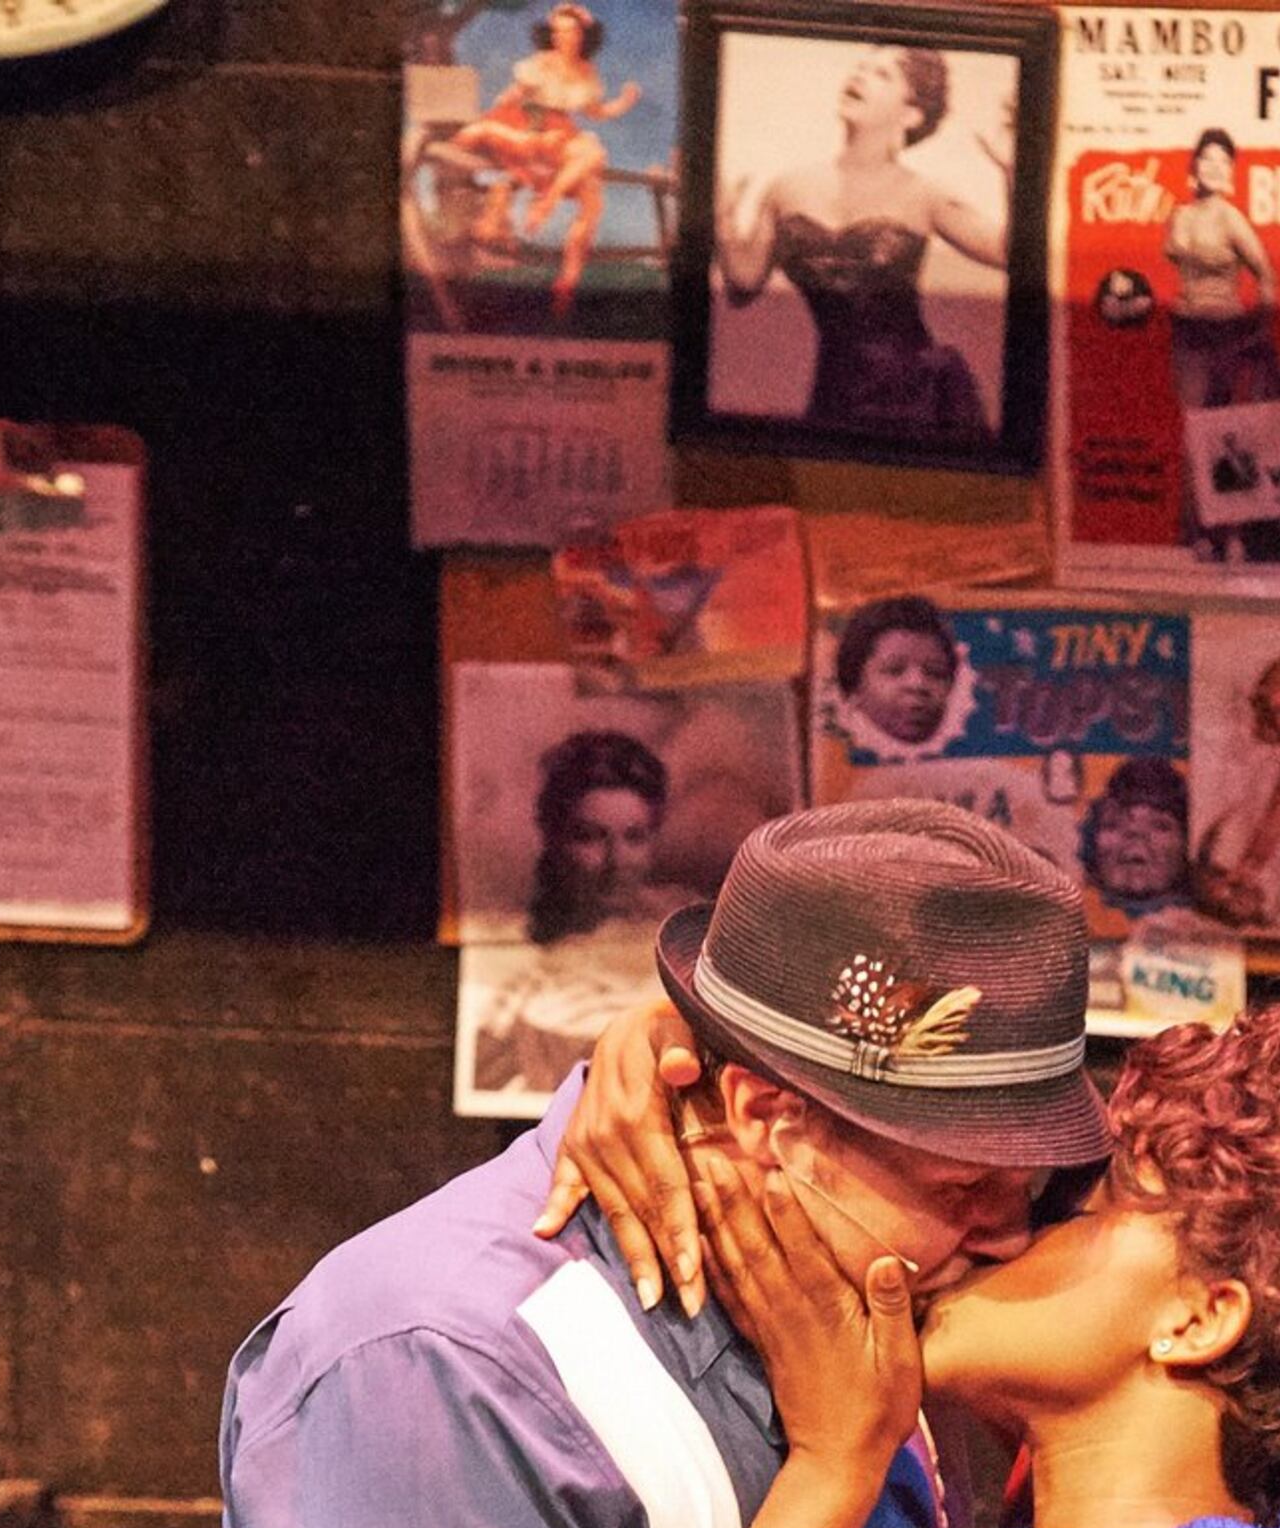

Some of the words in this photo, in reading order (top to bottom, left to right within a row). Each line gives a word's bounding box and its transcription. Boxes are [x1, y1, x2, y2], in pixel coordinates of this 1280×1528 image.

[1077, 17, 1245, 56] MAMBO
[1048, 622, 1152, 670] TINY
[1130, 964, 1216, 1003] KING
